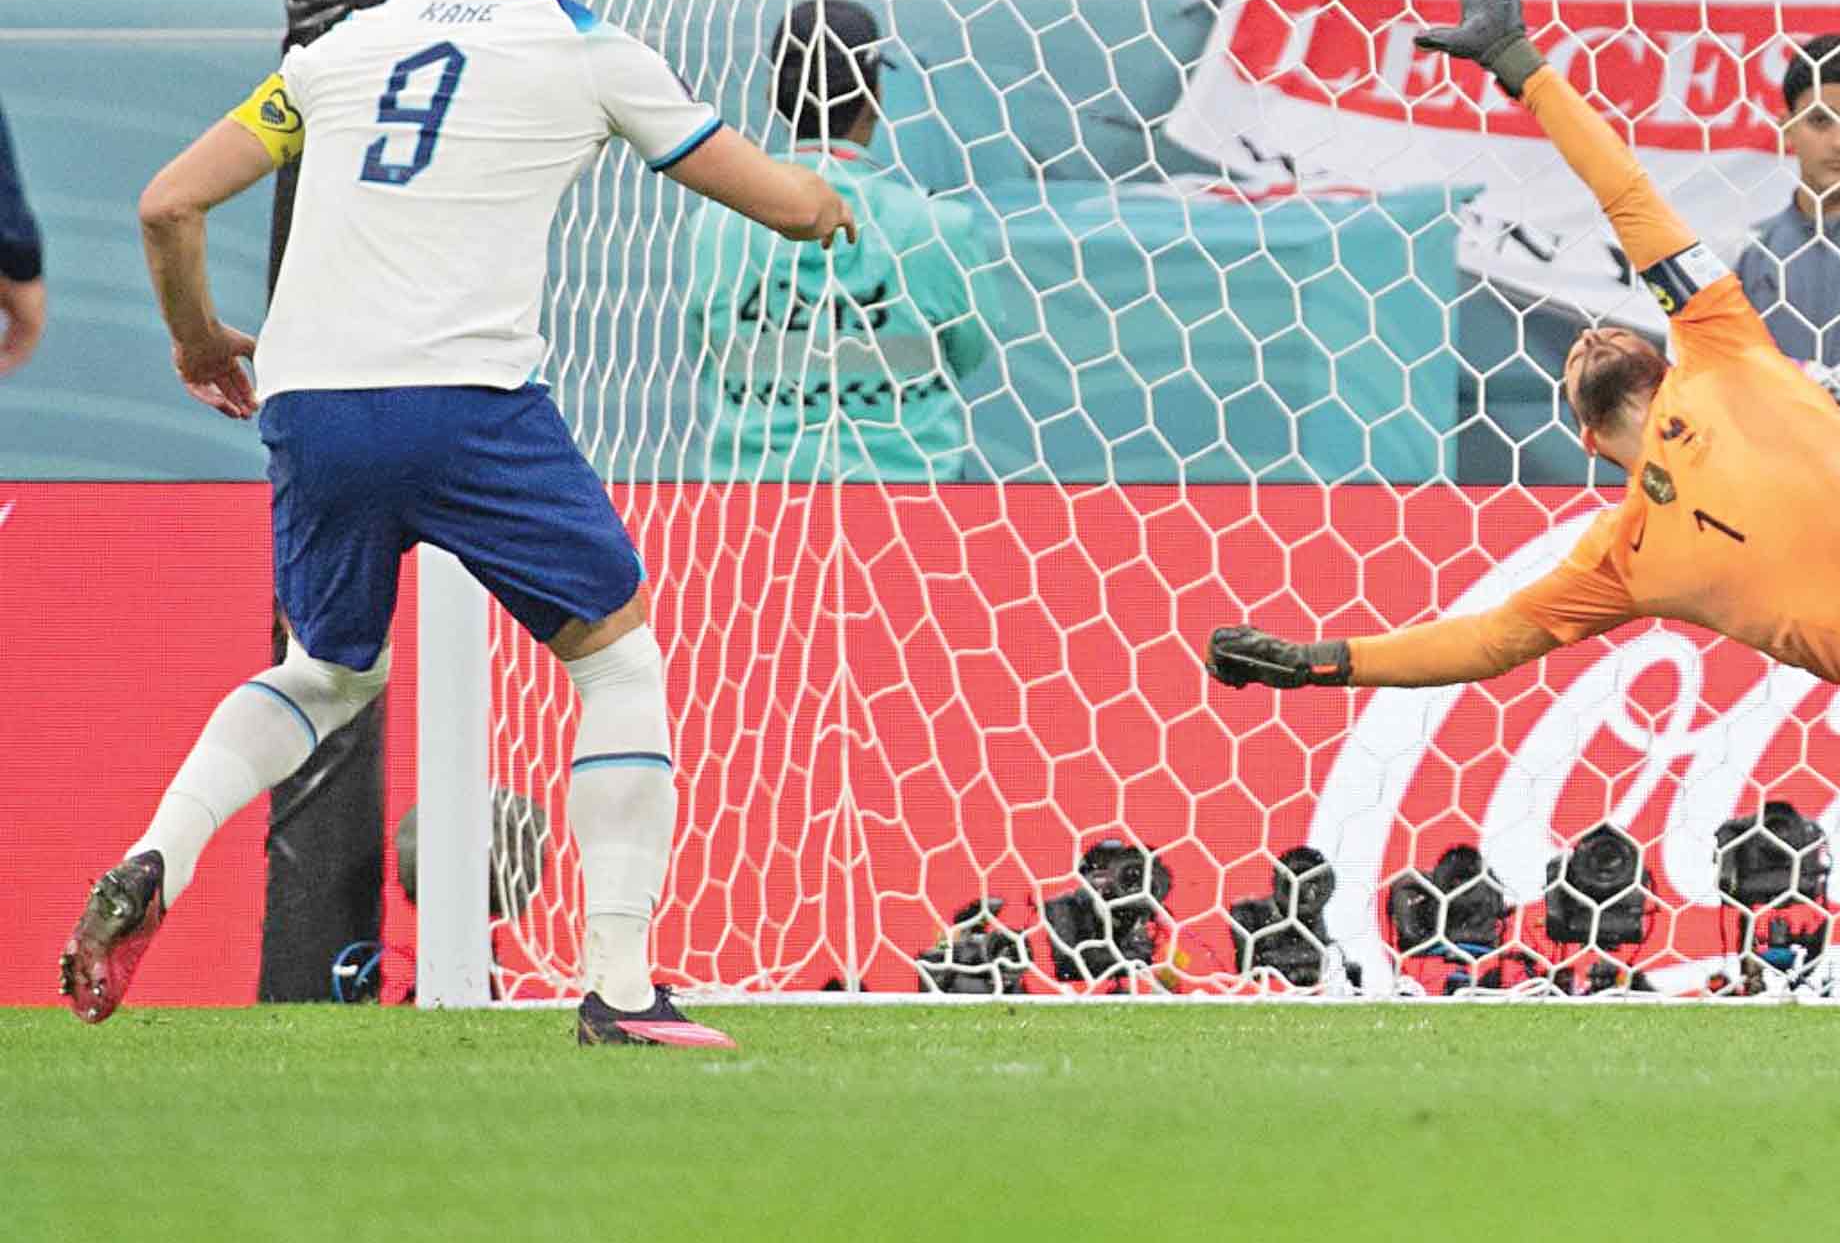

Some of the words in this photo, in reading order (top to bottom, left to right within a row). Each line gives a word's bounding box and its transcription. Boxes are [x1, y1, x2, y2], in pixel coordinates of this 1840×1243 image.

[418, 2, 501, 25] KANE
[357, 40, 469, 188] 9
[1692, 509, 1746, 543] 1
